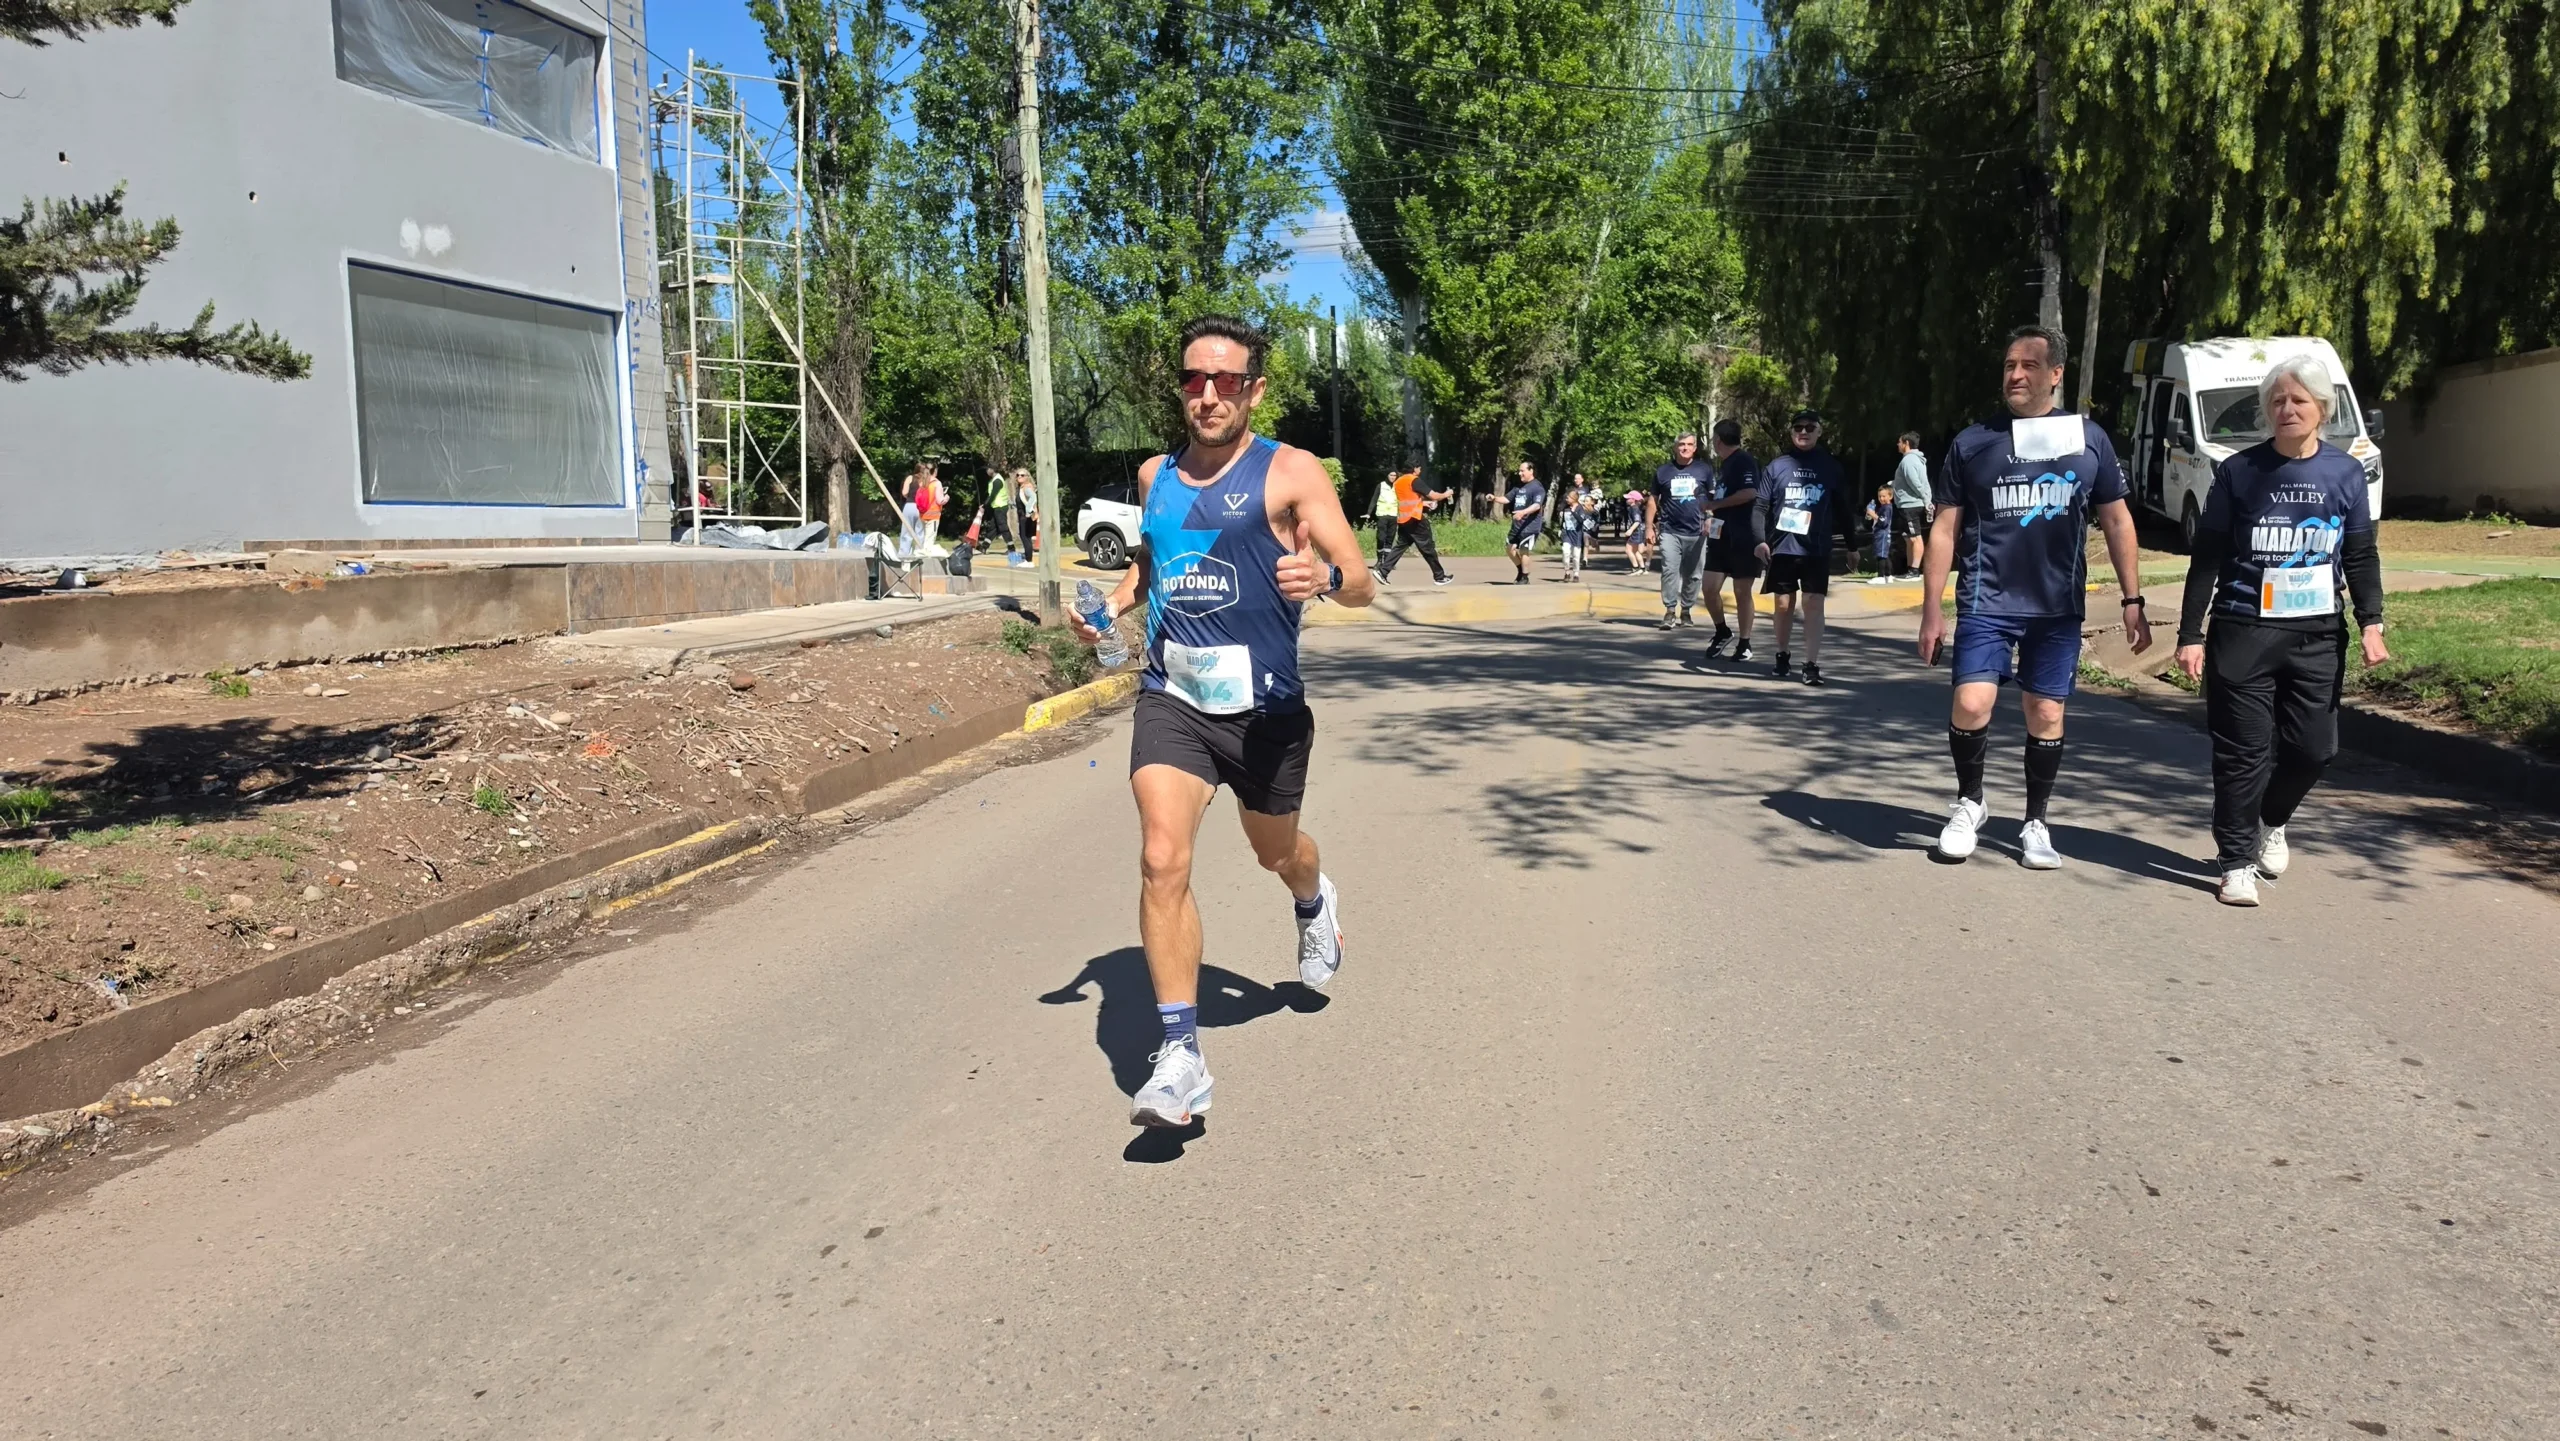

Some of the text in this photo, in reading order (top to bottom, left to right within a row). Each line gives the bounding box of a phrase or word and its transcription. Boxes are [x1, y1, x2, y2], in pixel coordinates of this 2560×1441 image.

[1992, 483, 2073, 509] MARATON
[2270, 492, 2326, 504] VALLEY
[1994, 510, 2011, 519] para
[2013, 508, 2032, 516] toda
[2044, 508, 2068, 516] familia
[2251, 527, 2338, 554] MARATON
[2252, 554, 2270, 562] para
[2273, 554, 2293, 562] toda
[2305, 554, 2333, 564] familia
[1185, 563, 1199, 573] LA
[1162, 575, 1230, 594] ROTONDA
[2284, 591, 2316, 608] 101
